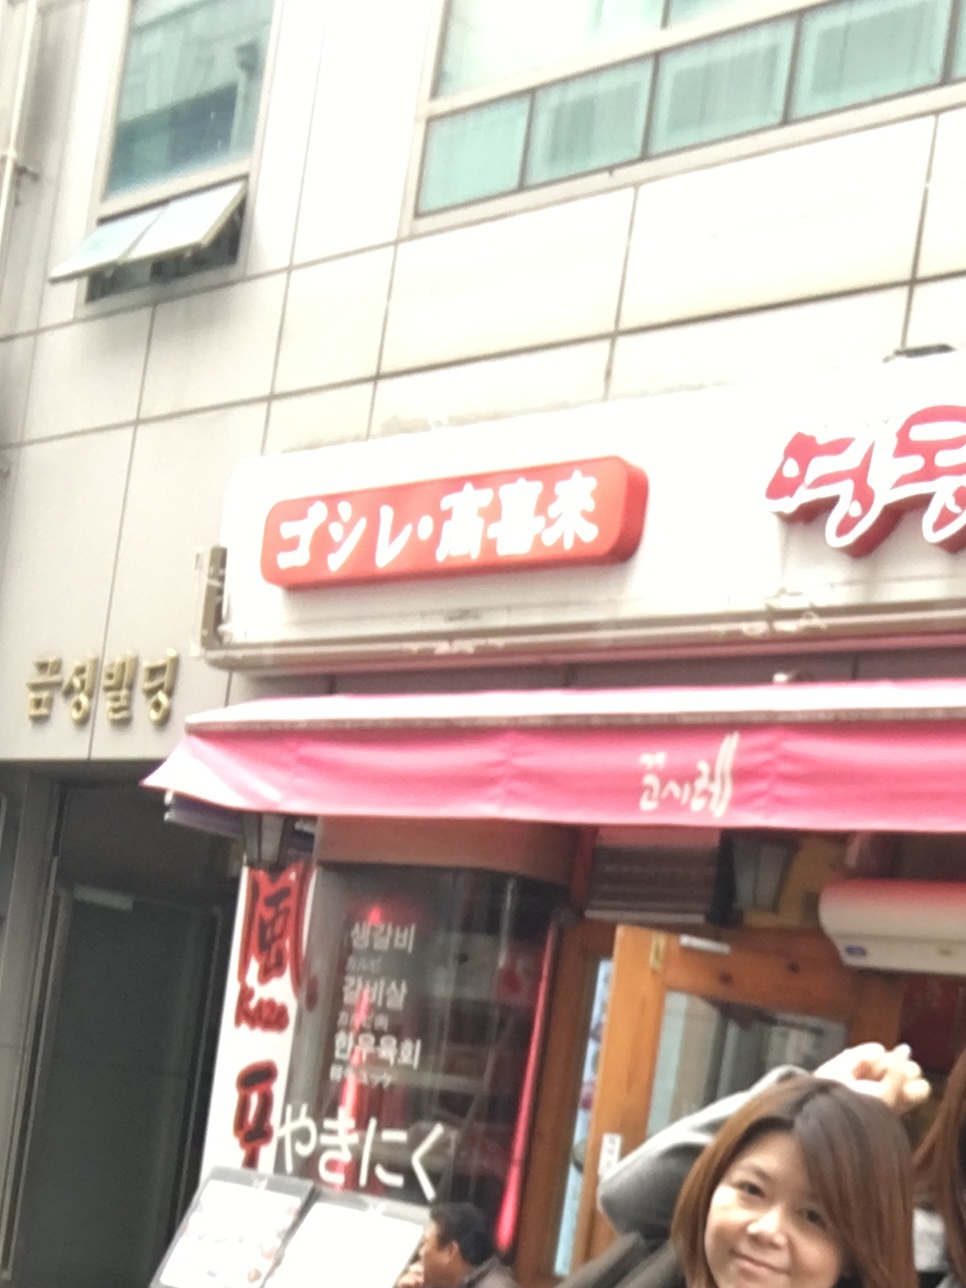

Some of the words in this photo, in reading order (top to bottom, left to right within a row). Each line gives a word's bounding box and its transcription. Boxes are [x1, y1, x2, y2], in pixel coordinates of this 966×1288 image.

[27, 648, 179, 727] 금성빌딩
[277, 1103, 444, 1202] やきにく
